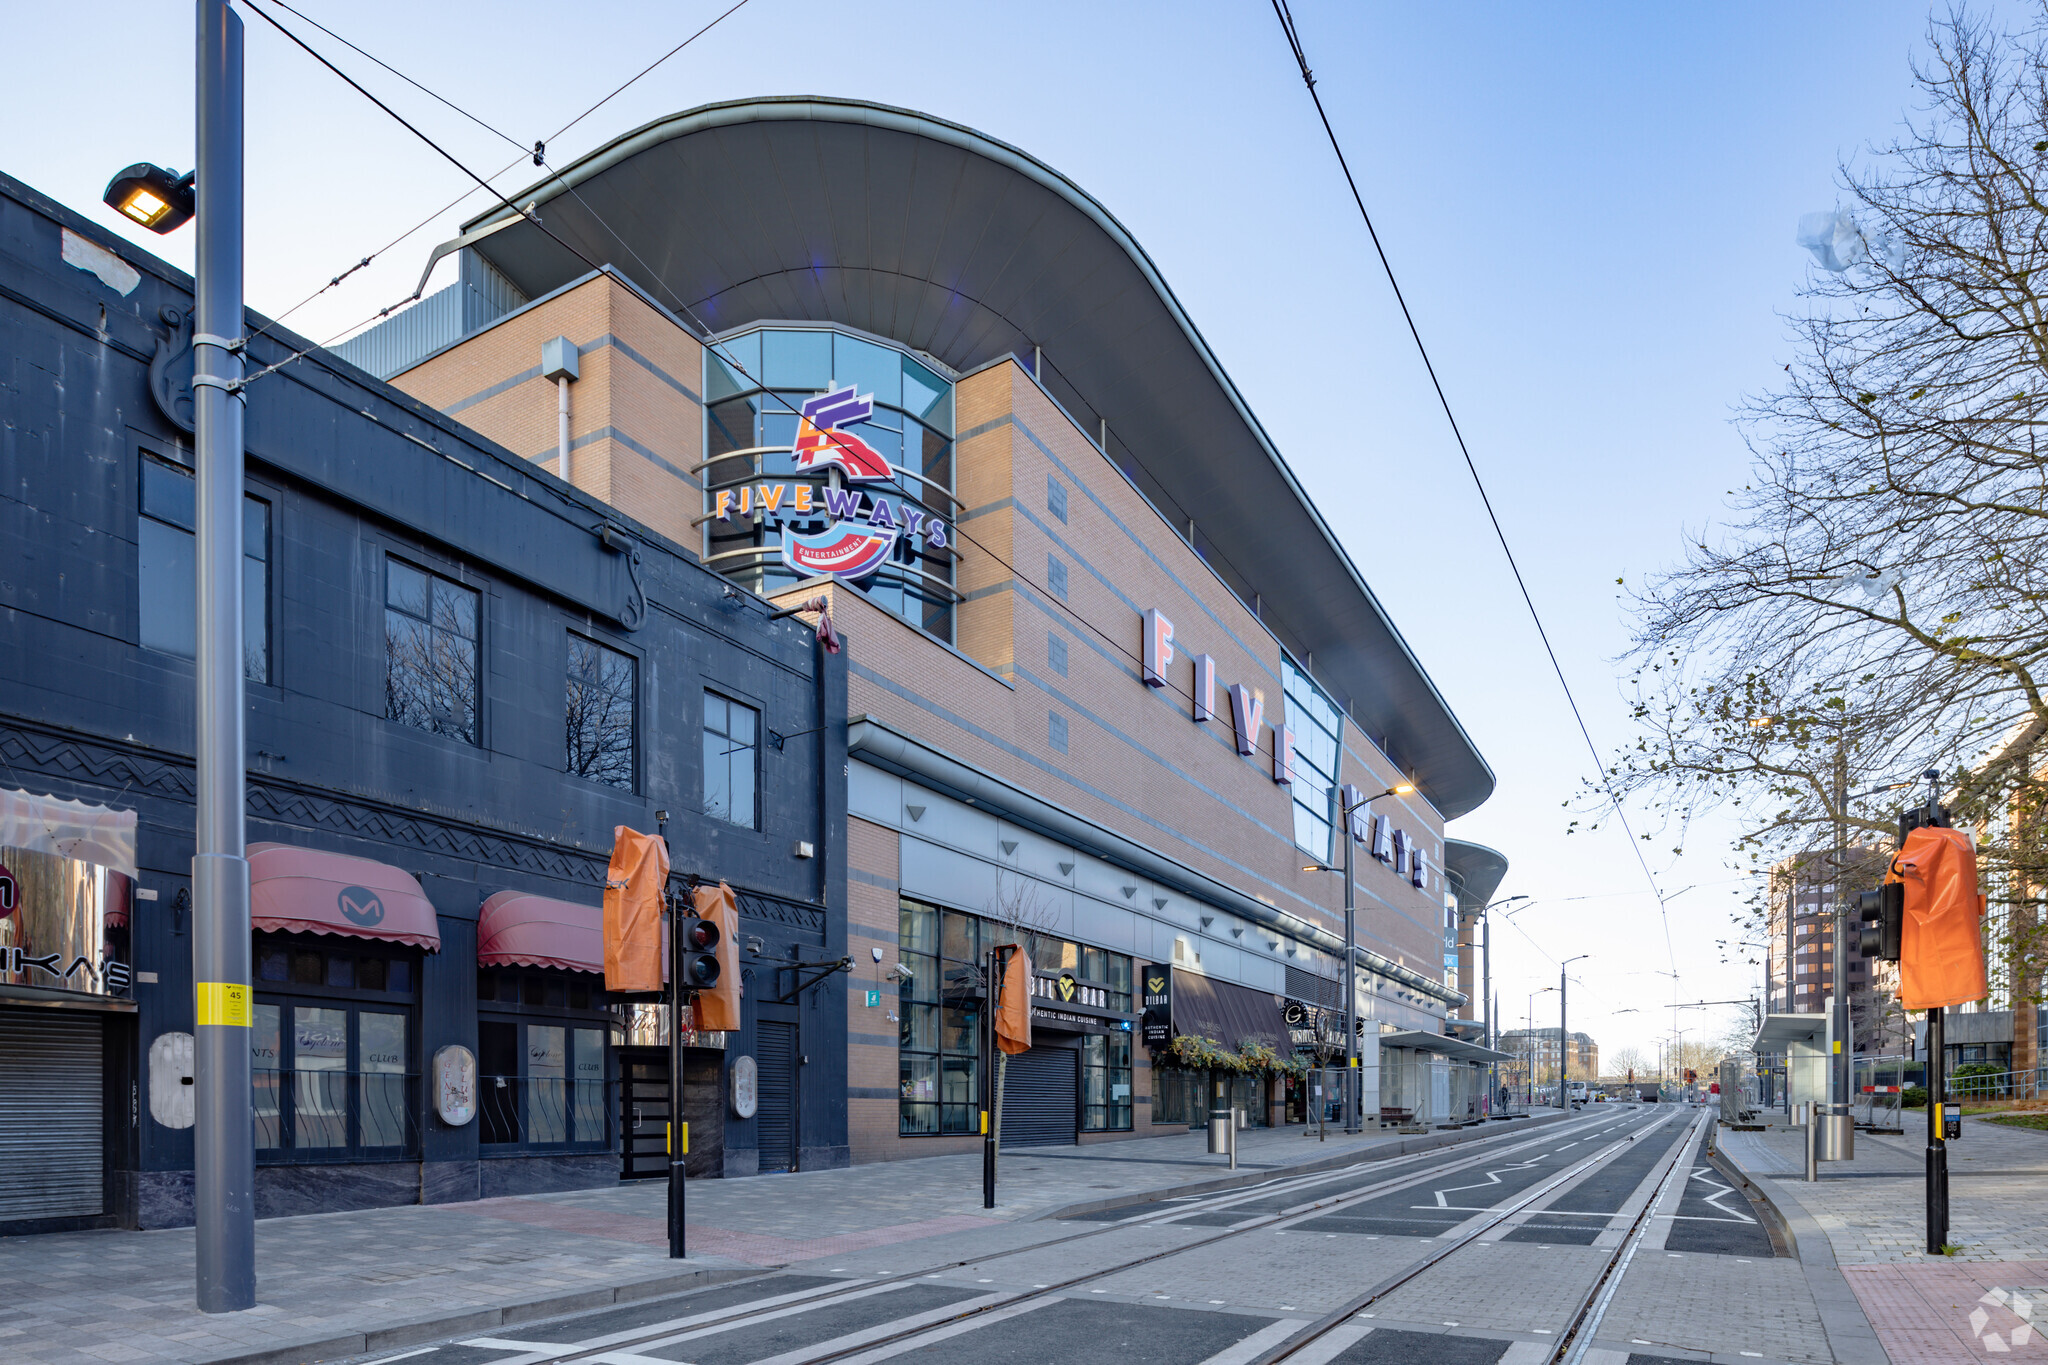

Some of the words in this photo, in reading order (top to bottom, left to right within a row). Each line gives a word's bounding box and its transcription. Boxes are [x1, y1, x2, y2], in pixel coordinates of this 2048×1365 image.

[716, 484, 813, 522] FIVE
[822, 485, 947, 549] WAYS
[799, 537, 862, 559] ENTERTAINMENT
[1143, 608, 1297, 785] FIVE
[1343, 784, 1428, 889] WAYS
[1082, 986, 1105, 1008] BAR
[1145, 995, 1167, 1006] DILBAR
[1057, 1014, 1076, 1022] INDIAN
[1077, 1016, 1097, 1025] CUISINE
[369, 1054, 398, 1062] CLUB
